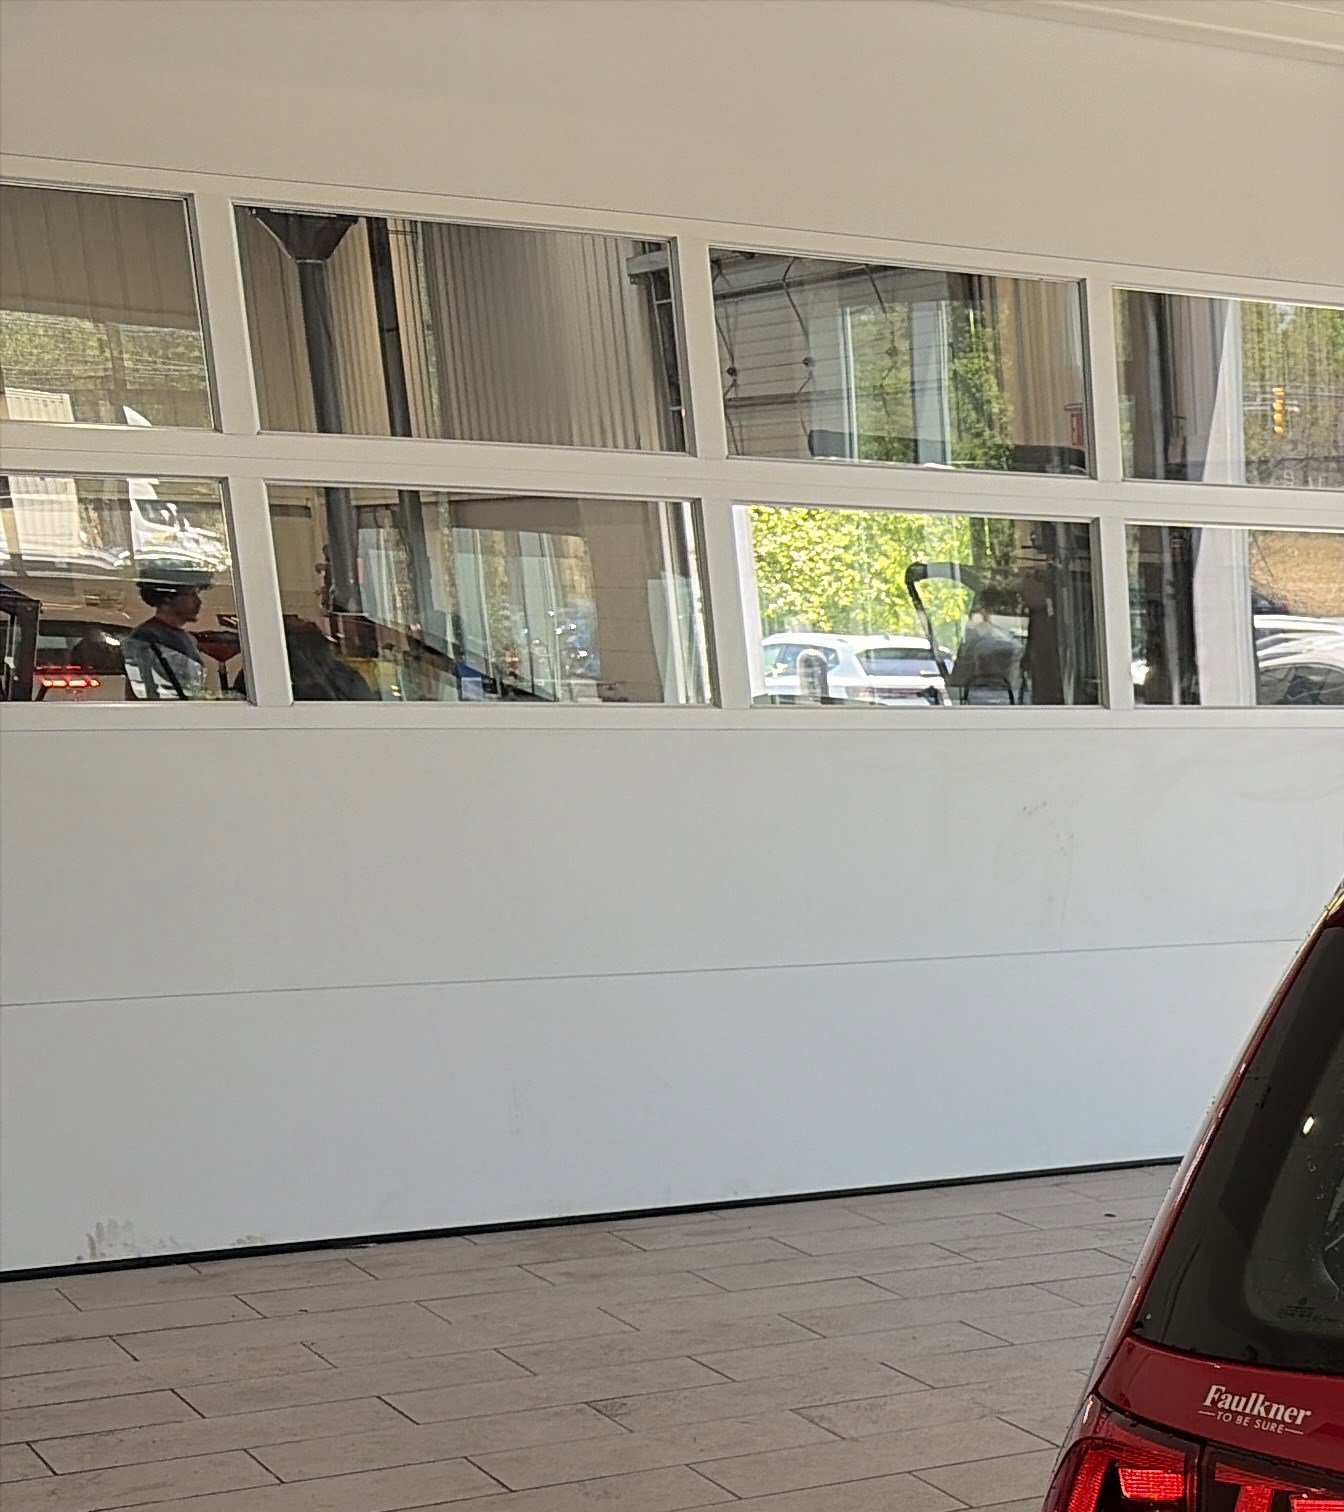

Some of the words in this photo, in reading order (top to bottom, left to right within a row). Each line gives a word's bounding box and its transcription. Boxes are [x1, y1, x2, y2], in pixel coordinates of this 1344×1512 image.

[1202, 1384, 1312, 1425] Faulkner
[1216, 1410, 1233, 1423] TO
[1235, 1415, 1251, 1427] BE
[1253, 1418, 1285, 1434] SURE
